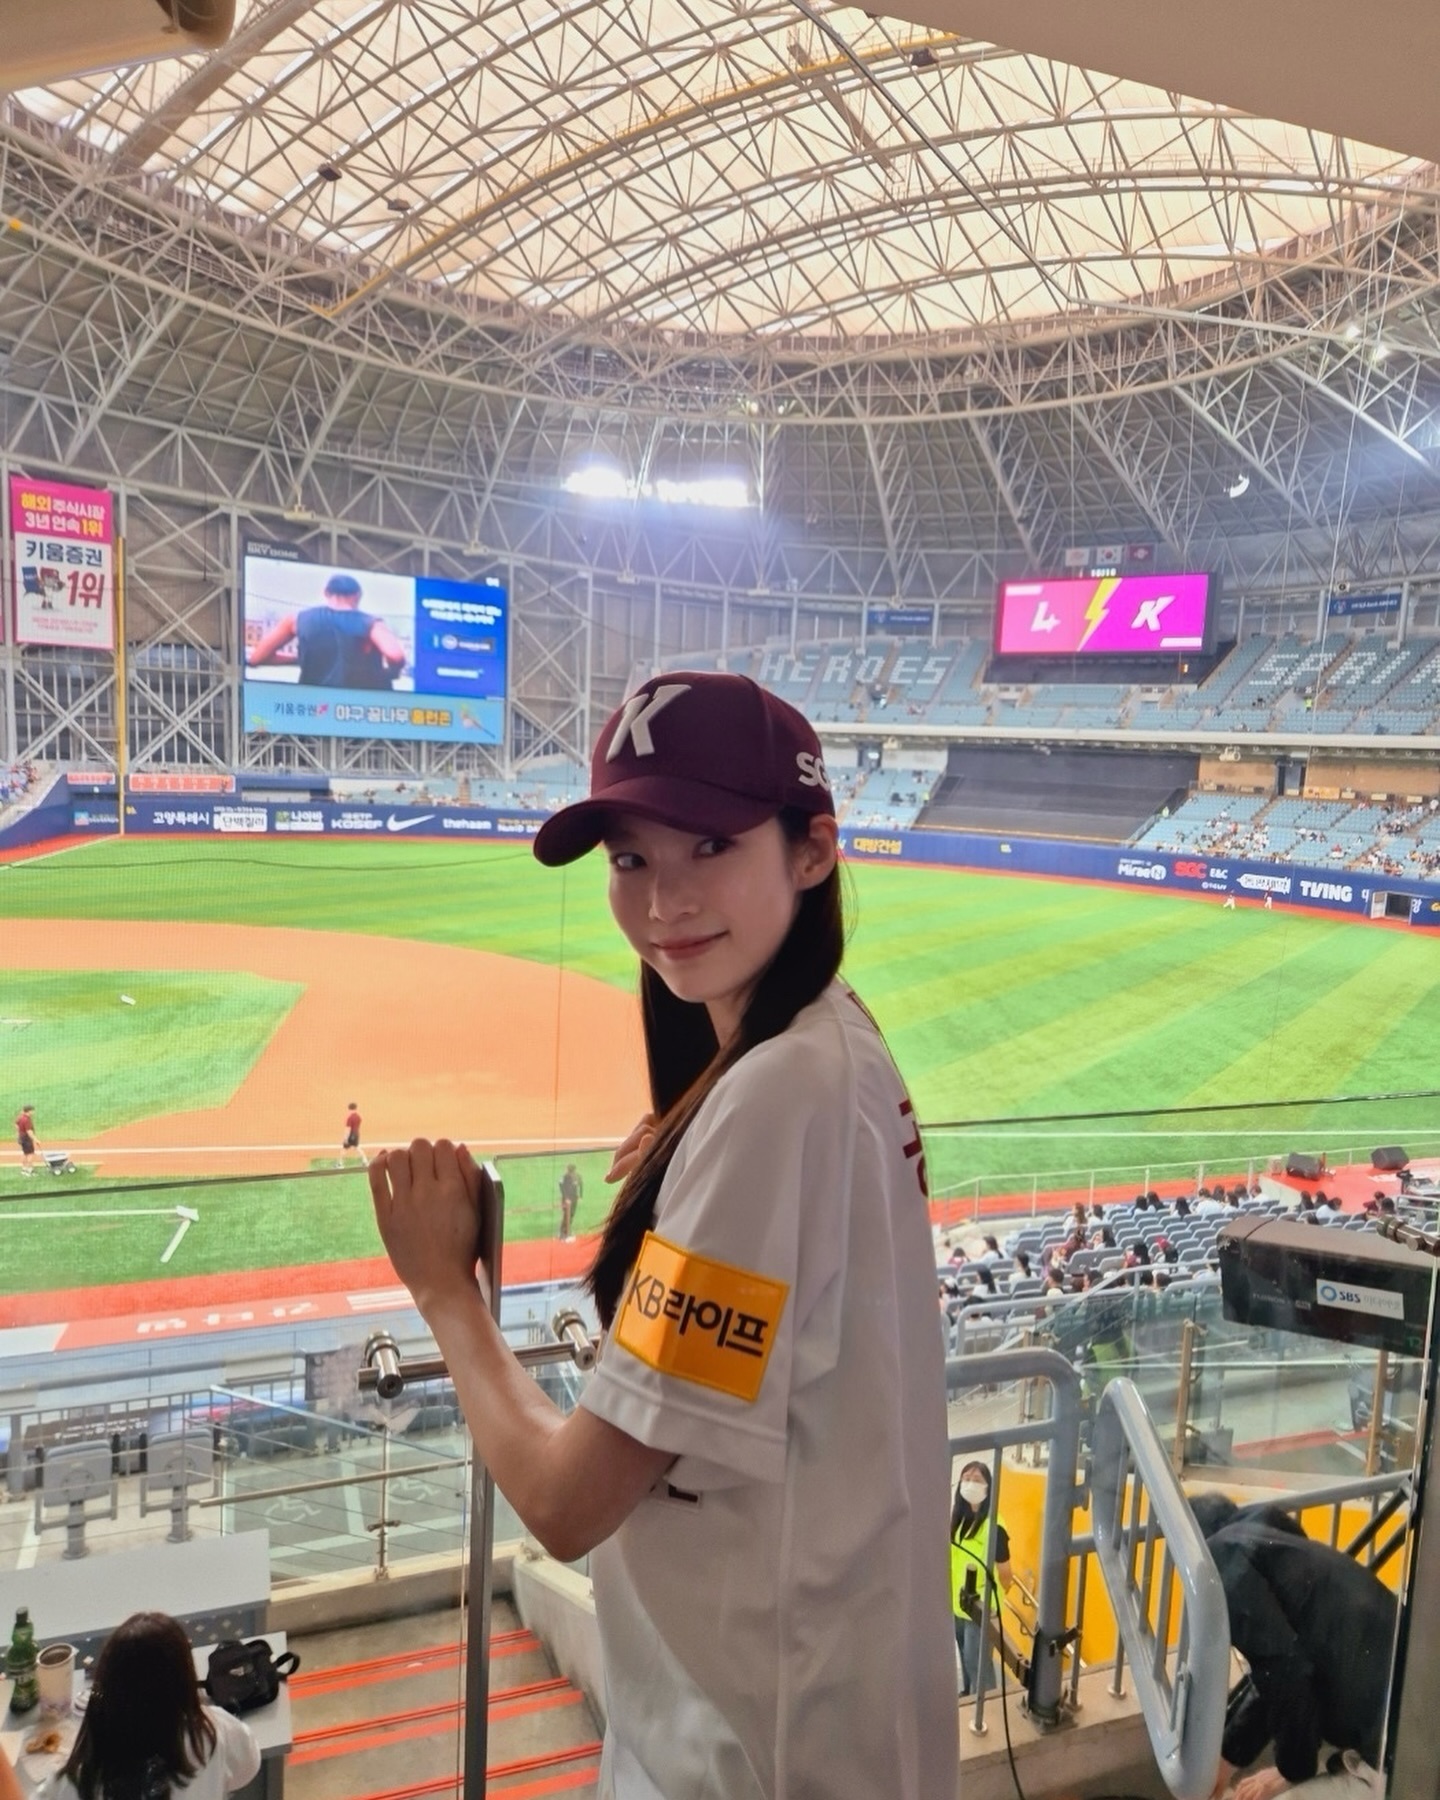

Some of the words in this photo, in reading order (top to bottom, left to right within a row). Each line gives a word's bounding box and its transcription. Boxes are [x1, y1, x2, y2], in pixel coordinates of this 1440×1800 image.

[21, 493, 51, 513] 해외
[53, 499, 104, 520] 주식시장
[25, 512, 50, 530] 3년
[52, 516, 80, 535] 연속
[81, 518, 103, 537] 1위
[26, 540, 102, 567] 키움증권
[67, 570, 105, 609] 1위
[1131, 595, 1176, 632] K
[758, 653, 952, 685] HEROES
[335, 704, 365, 722] 야구
[367, 705, 410, 724] 꿈나무
[606, 683, 692, 763] K
[153, 811, 209, 826] 고양특례시
[854, 837, 902, 855] 대방건설
[1174, 860, 1207, 879] SGC
[1300, 880, 1353, 903] TVING
[1339, 1290, 1361, 1303] SBS
[628, 1267, 769, 1358] KB라이프
